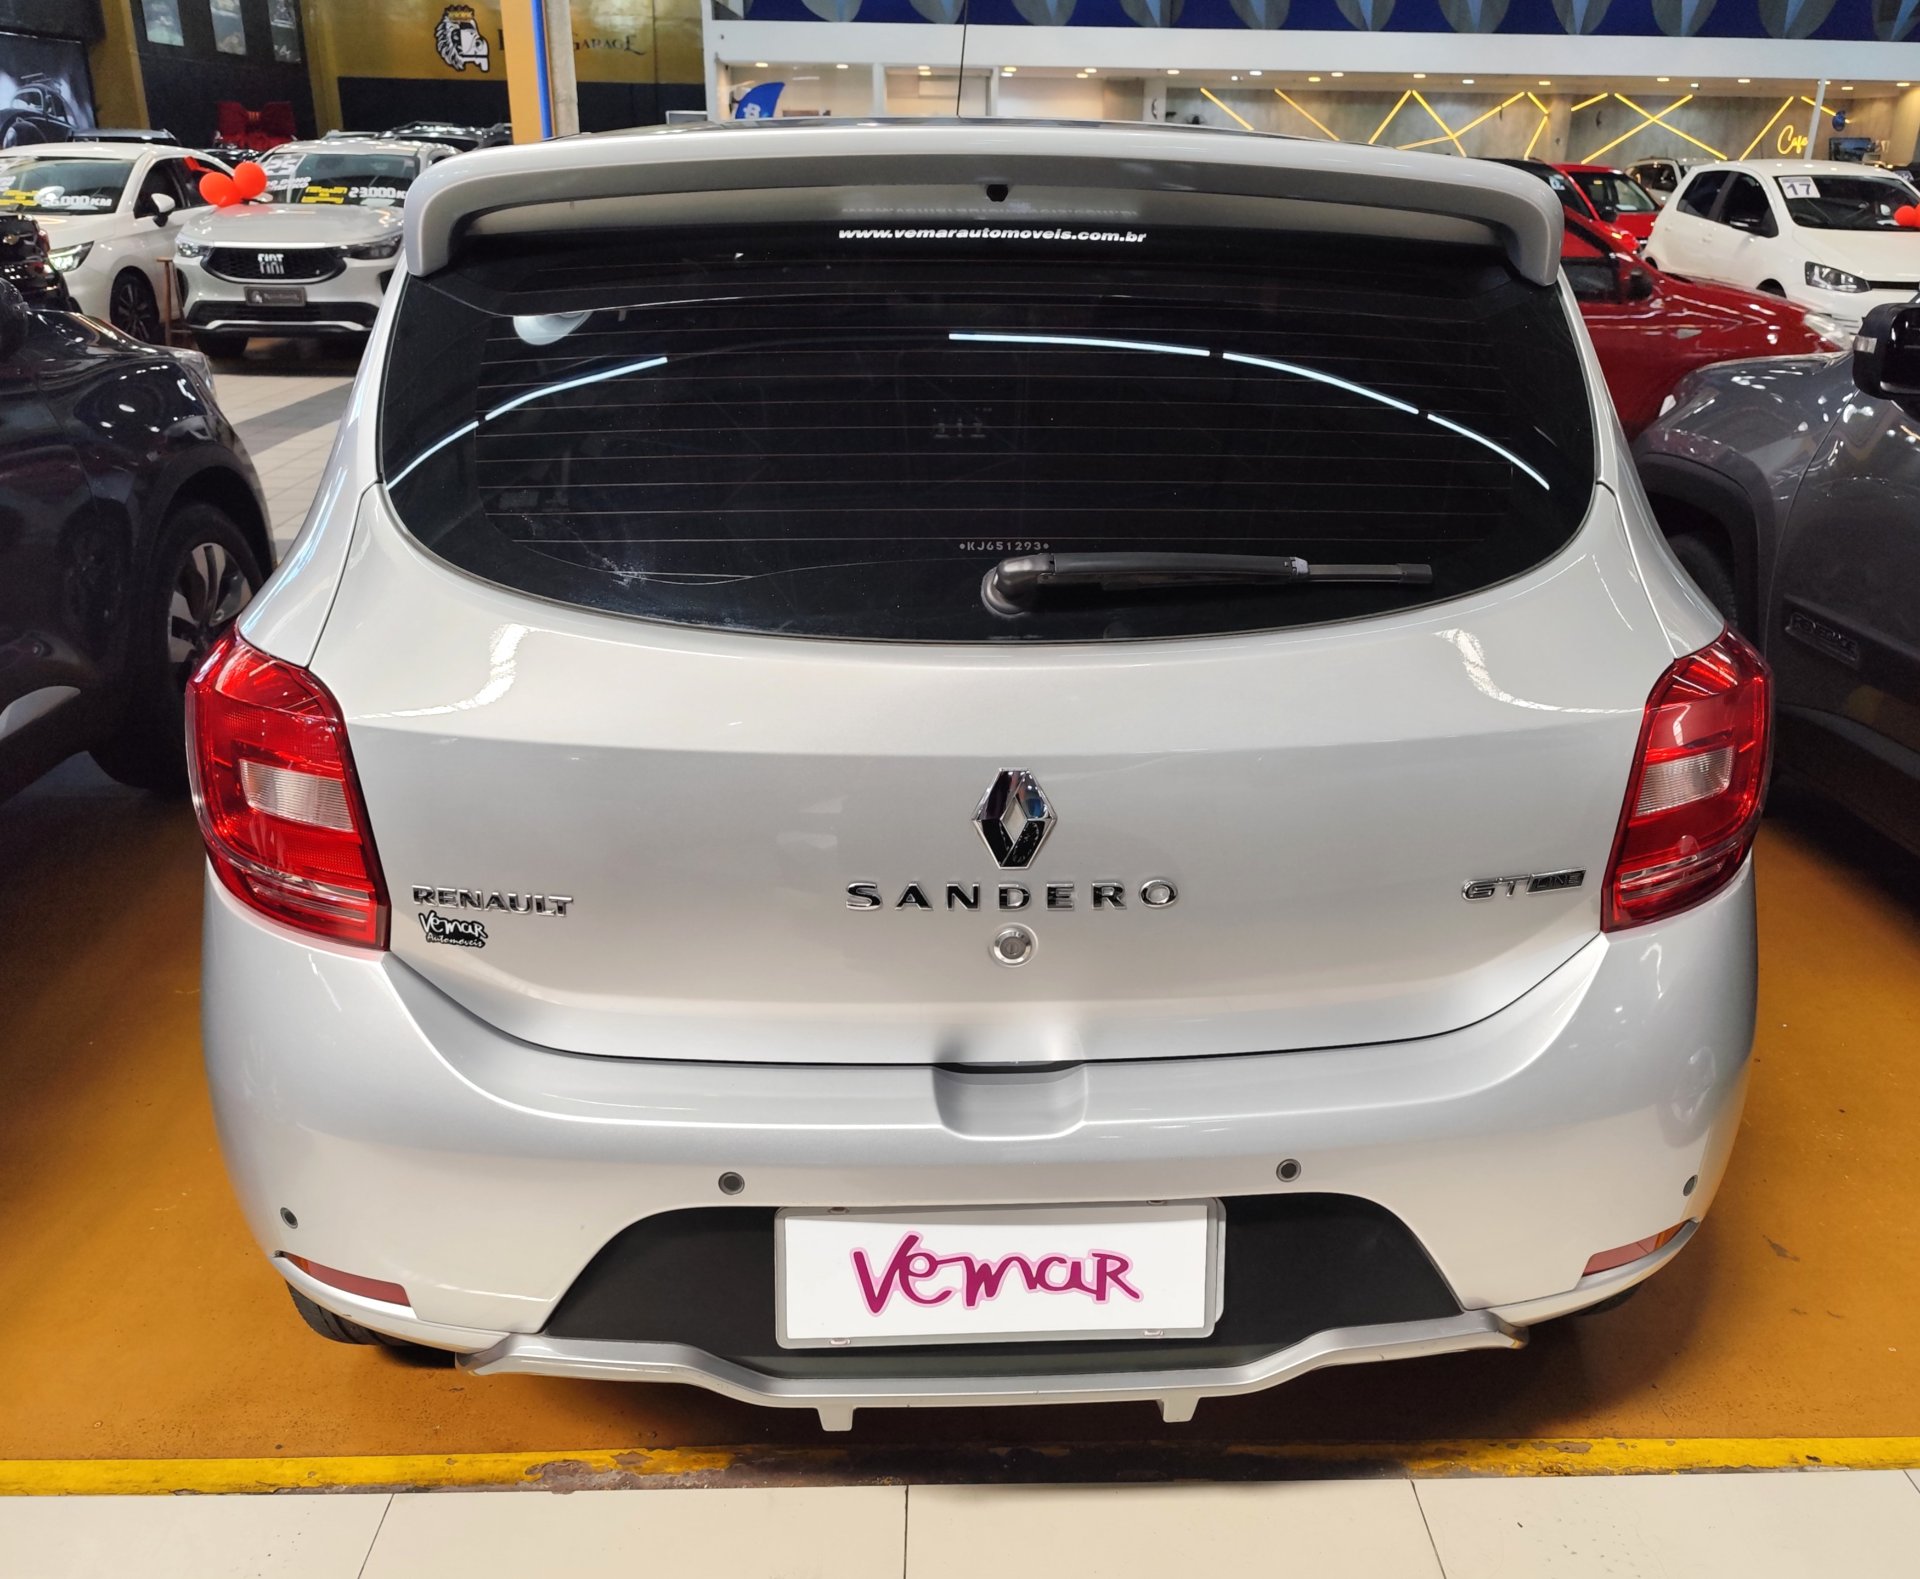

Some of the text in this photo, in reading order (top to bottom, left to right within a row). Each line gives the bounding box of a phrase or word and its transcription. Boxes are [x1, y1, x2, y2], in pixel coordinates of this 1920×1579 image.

[1787, 183, 1811, 196] 17
[91, 198, 112, 207] KM
[838, 227, 1147, 243] www.vemarautomoveis.com.br
[257, 253, 284, 275] FIAT
[412, 885, 574, 917] RENAULT
[846, 880, 1179, 911] SANDERO
